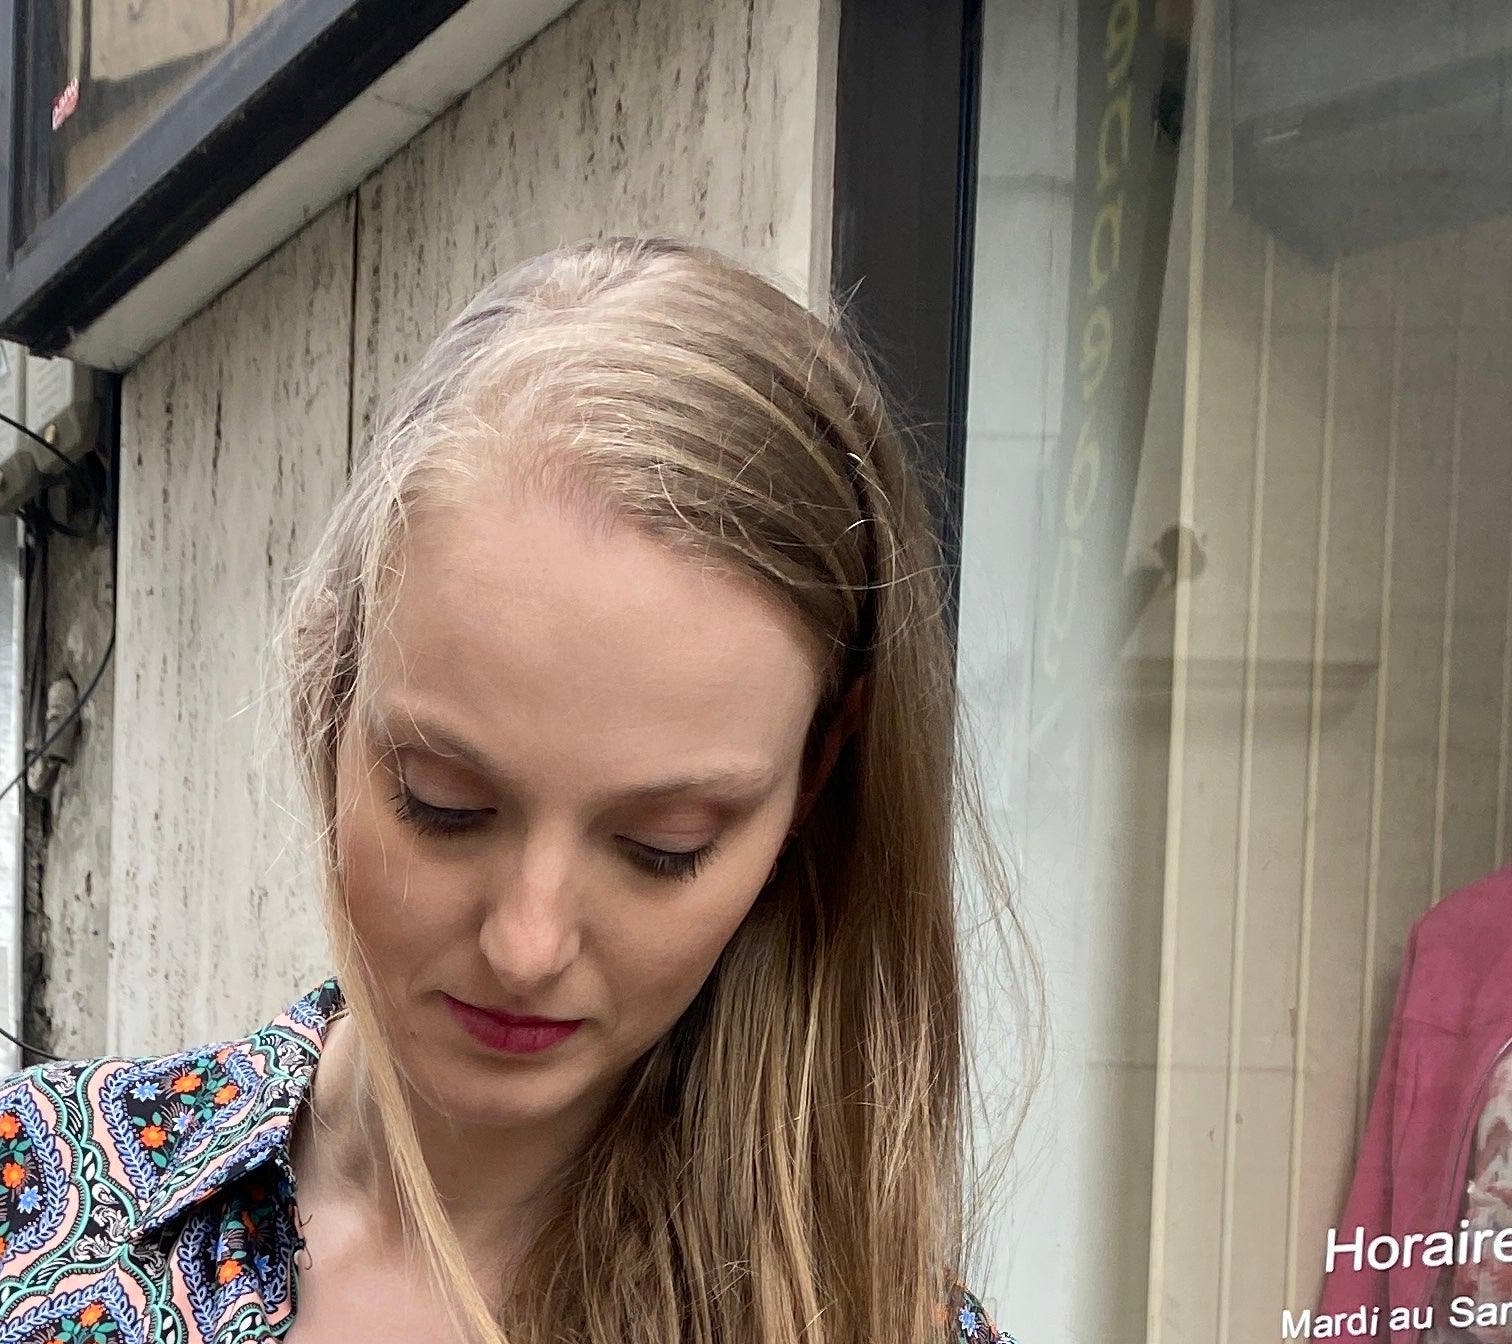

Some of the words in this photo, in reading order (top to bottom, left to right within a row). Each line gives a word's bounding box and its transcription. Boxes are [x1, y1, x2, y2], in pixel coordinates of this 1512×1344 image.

[1325, 1219, 1512, 1273] Horaire
[1281, 1306, 1380, 1339] Mardi
[1389, 1306, 1434, 1331] au
